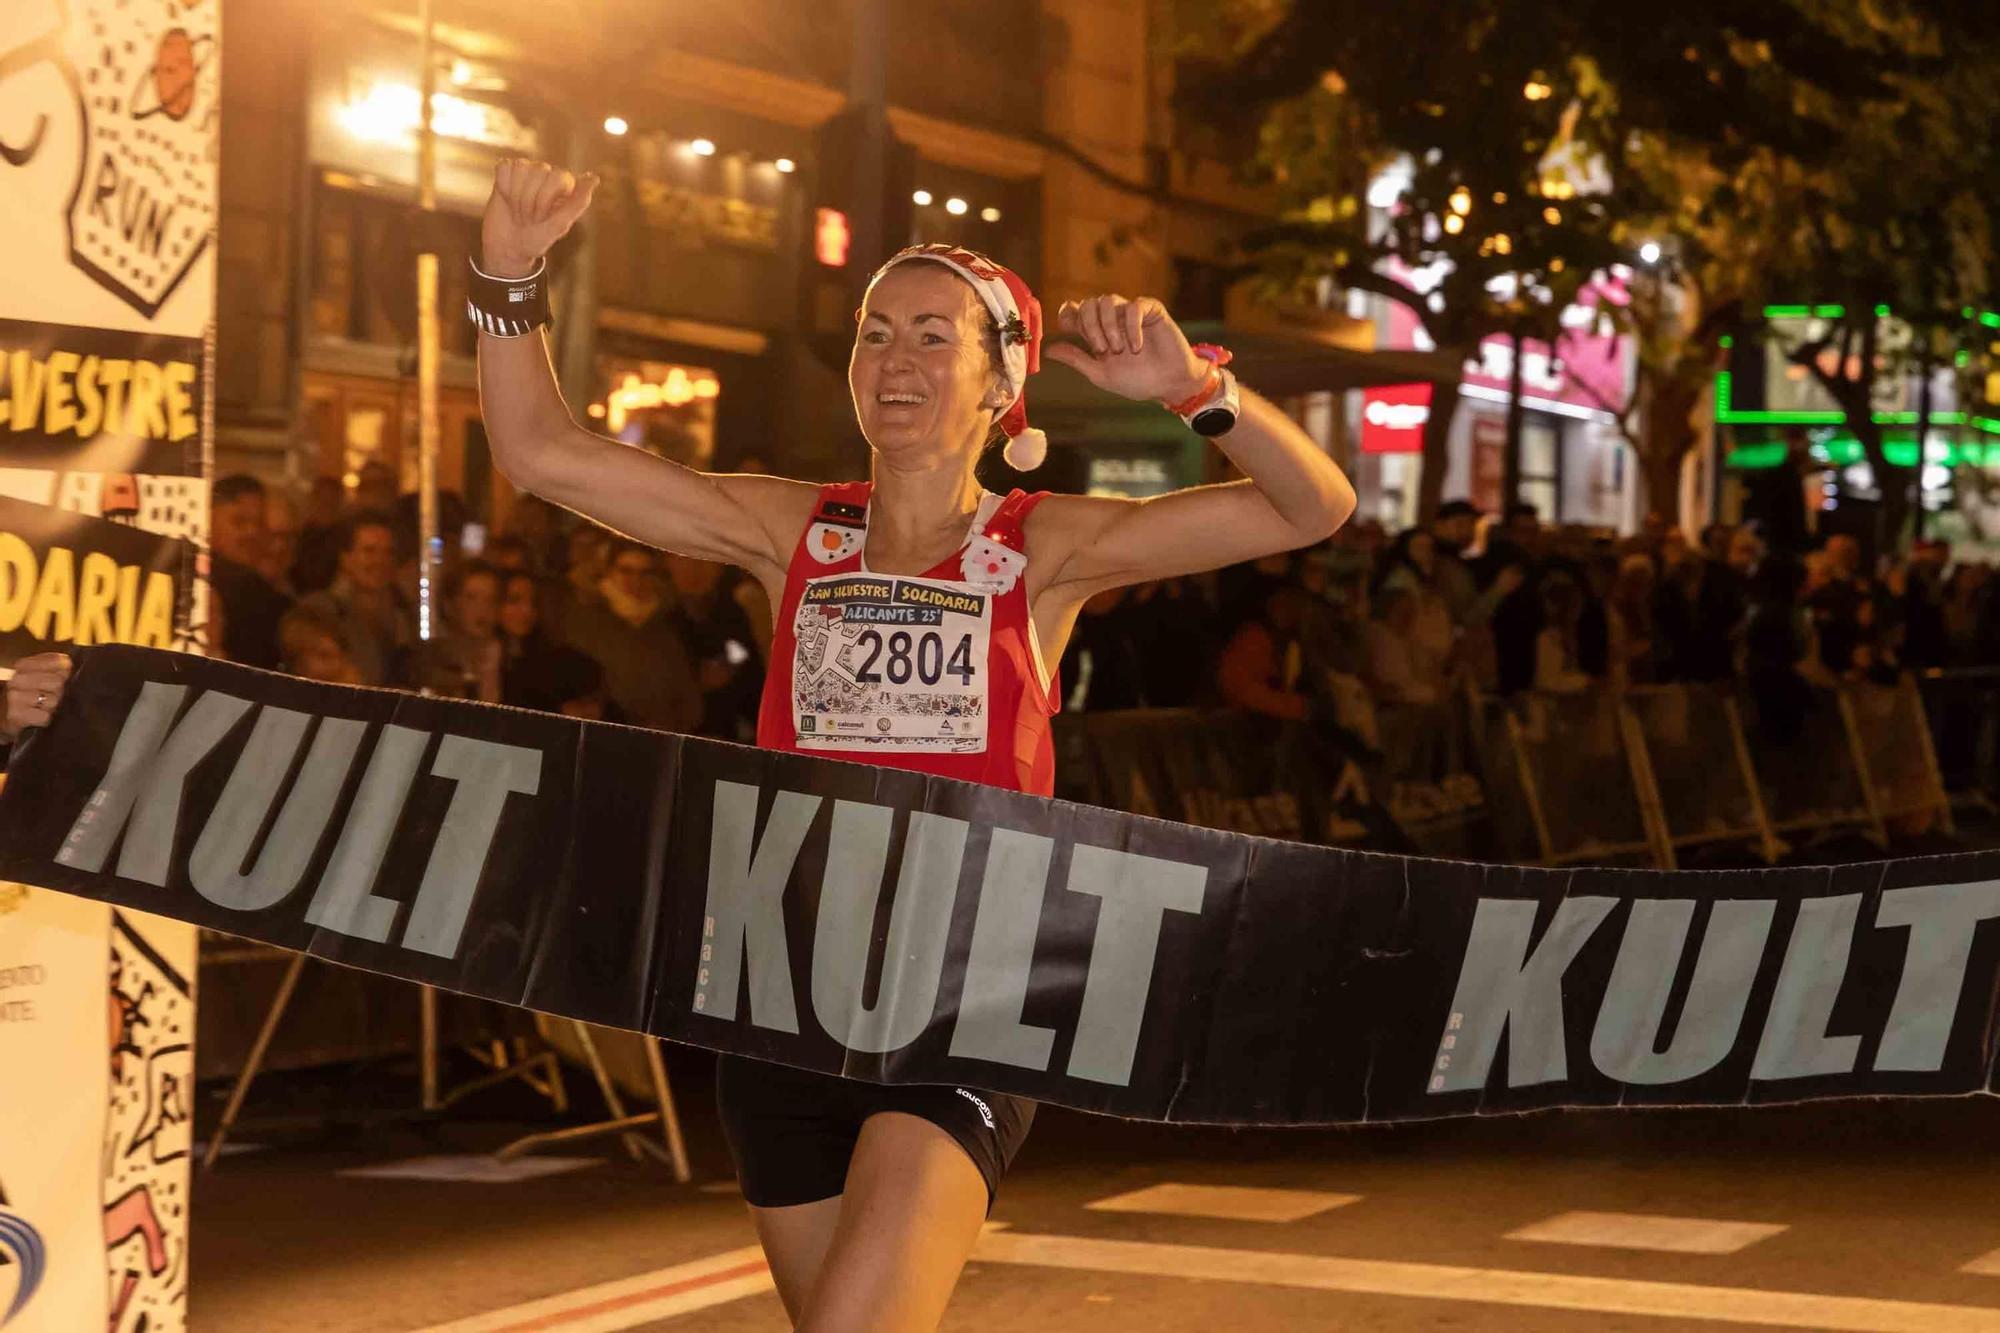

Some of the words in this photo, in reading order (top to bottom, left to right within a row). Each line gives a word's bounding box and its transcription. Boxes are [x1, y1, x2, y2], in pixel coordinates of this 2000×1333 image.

[88, 152, 175, 259] RUN
[809, 588, 831, 600] SAN
[833, 584, 890, 599] SILVESTRE
[901, 585, 981, 613] SOLIDARIA
[845, 606, 916, 622] ALICANTE
[855, 629, 976, 686] 2804
[54, 681, 543, 959] KULT
[692, 779, 1208, 1087] KULT
[1426, 879, 2000, 1095] KULT
